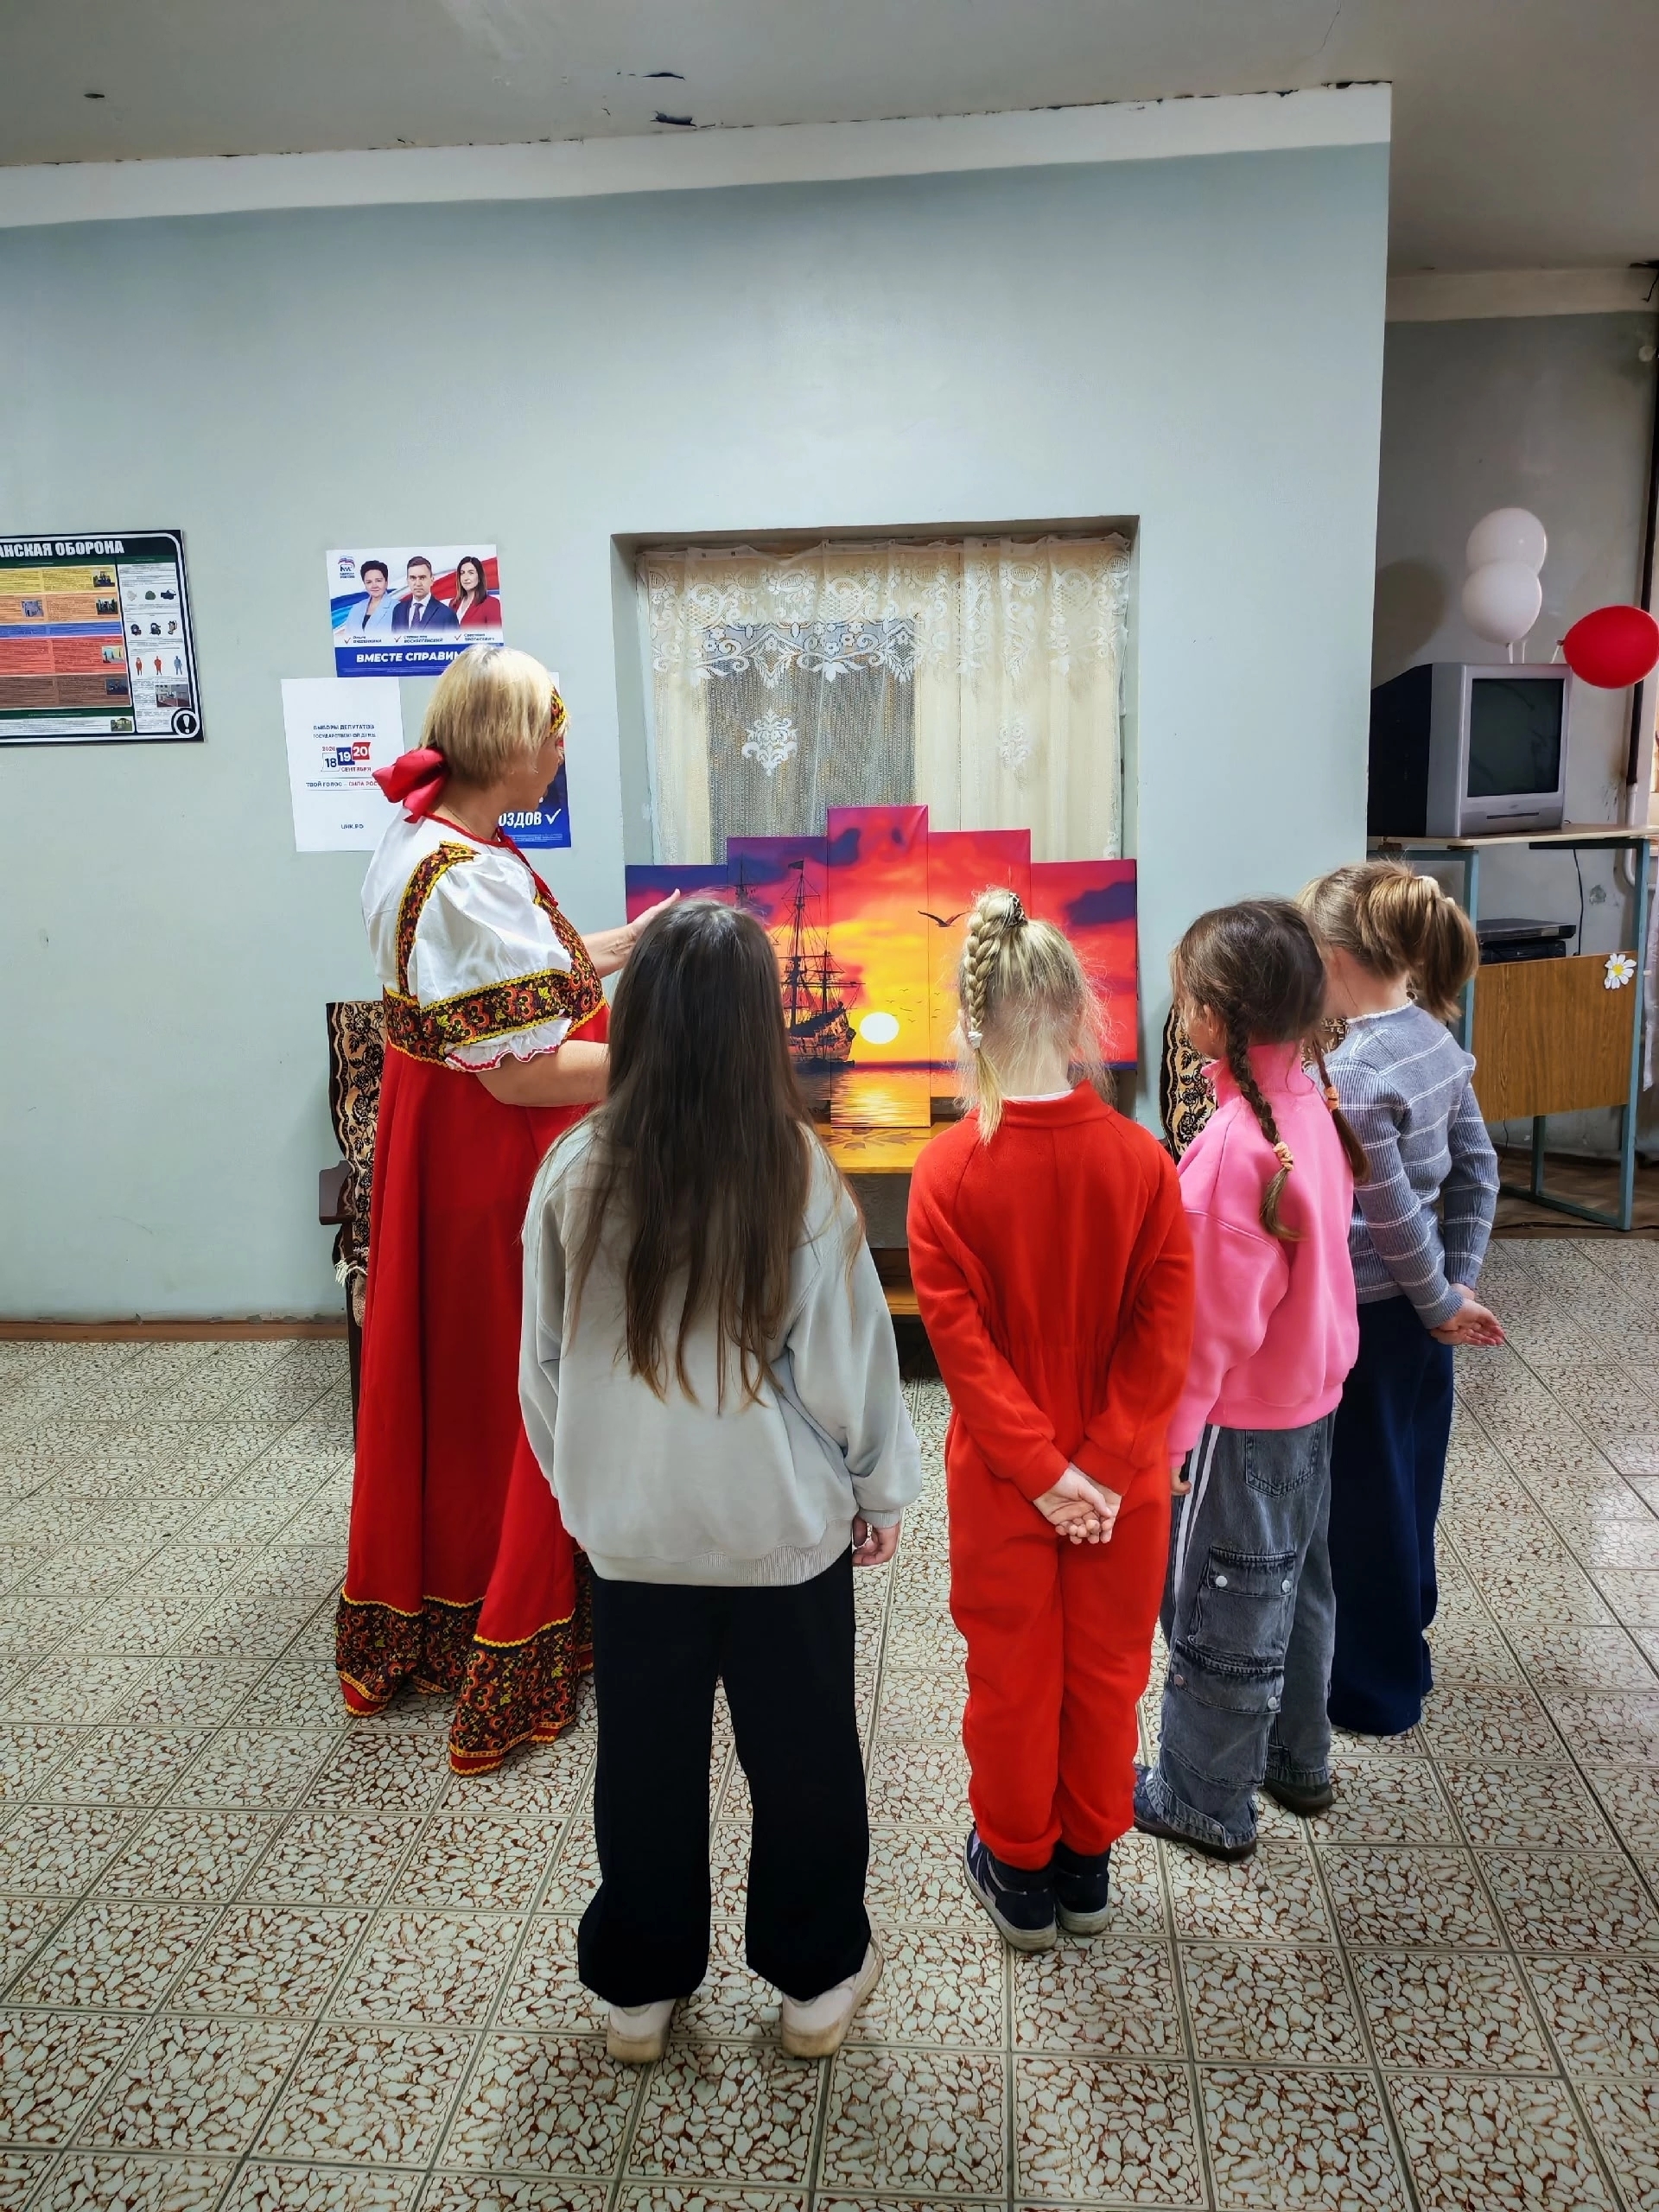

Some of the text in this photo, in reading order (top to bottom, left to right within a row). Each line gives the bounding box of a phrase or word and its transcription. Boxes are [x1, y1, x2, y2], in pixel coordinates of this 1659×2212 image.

[54, 541, 125, 556] ОБОРОНА
[356, 652, 403, 663] ВМЕСТЕ
[324, 746, 368, 768] 18 19 20
